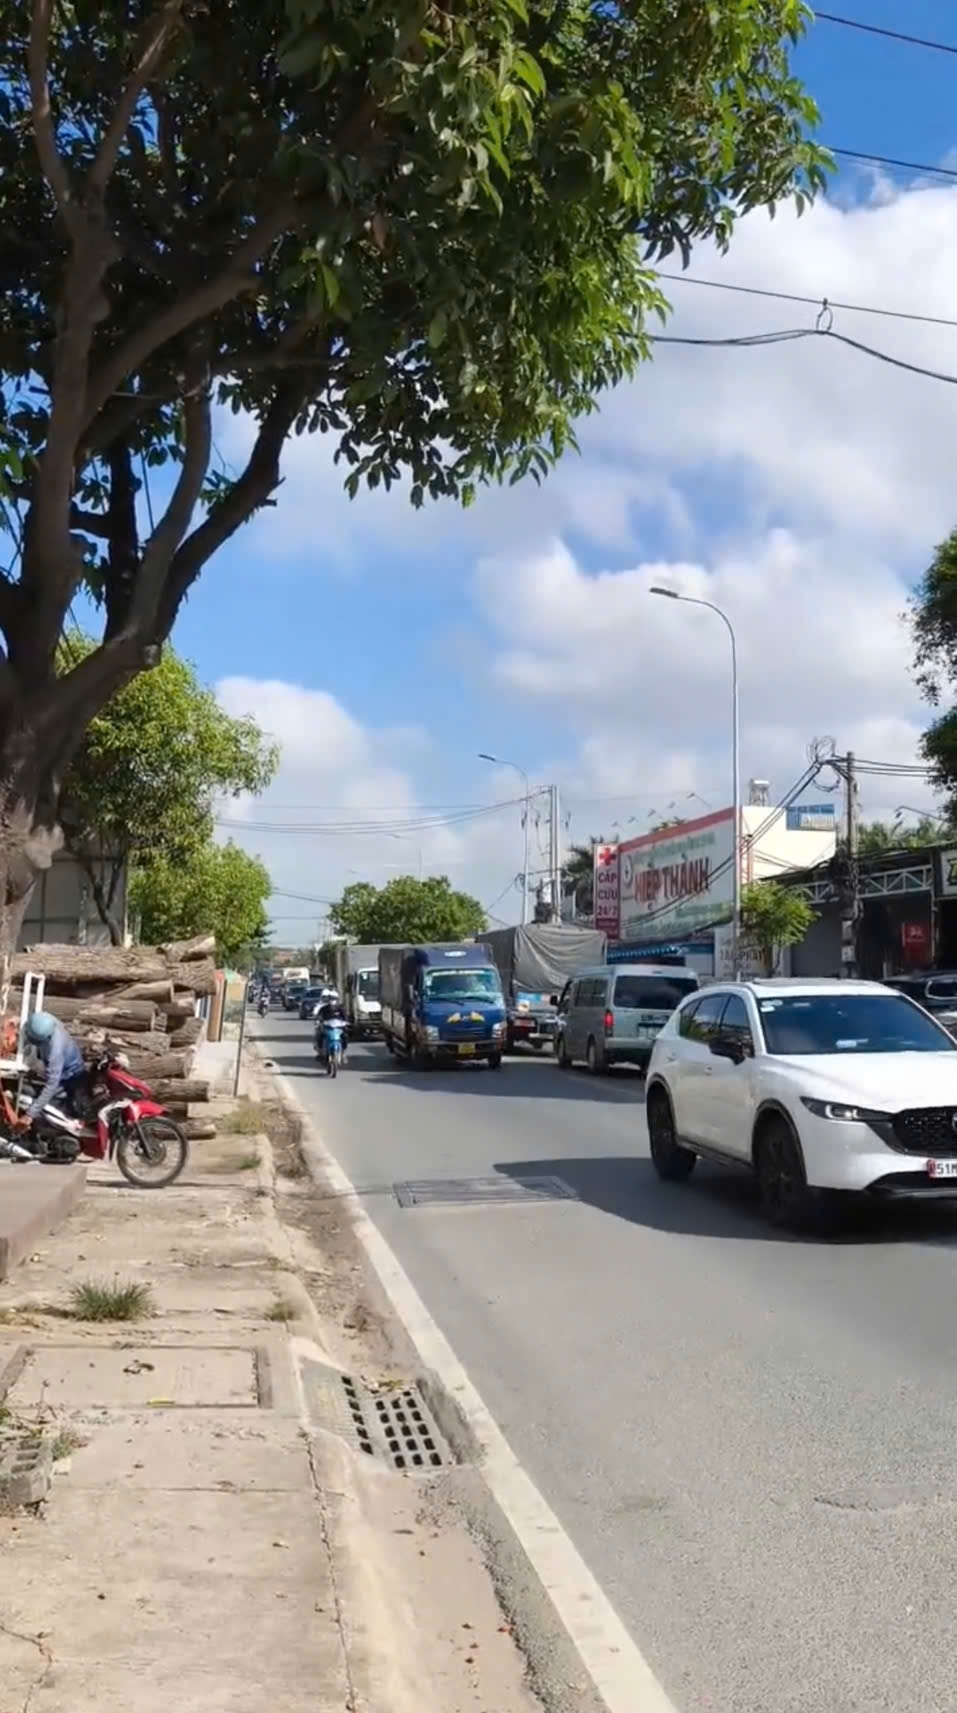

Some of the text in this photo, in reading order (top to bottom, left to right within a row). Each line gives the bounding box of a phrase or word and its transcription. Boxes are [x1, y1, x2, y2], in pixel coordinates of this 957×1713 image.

[598, 869, 617, 884] CẤP
[662, 853, 710, 900] THÀNH
[598, 905, 618, 917] 24/7
